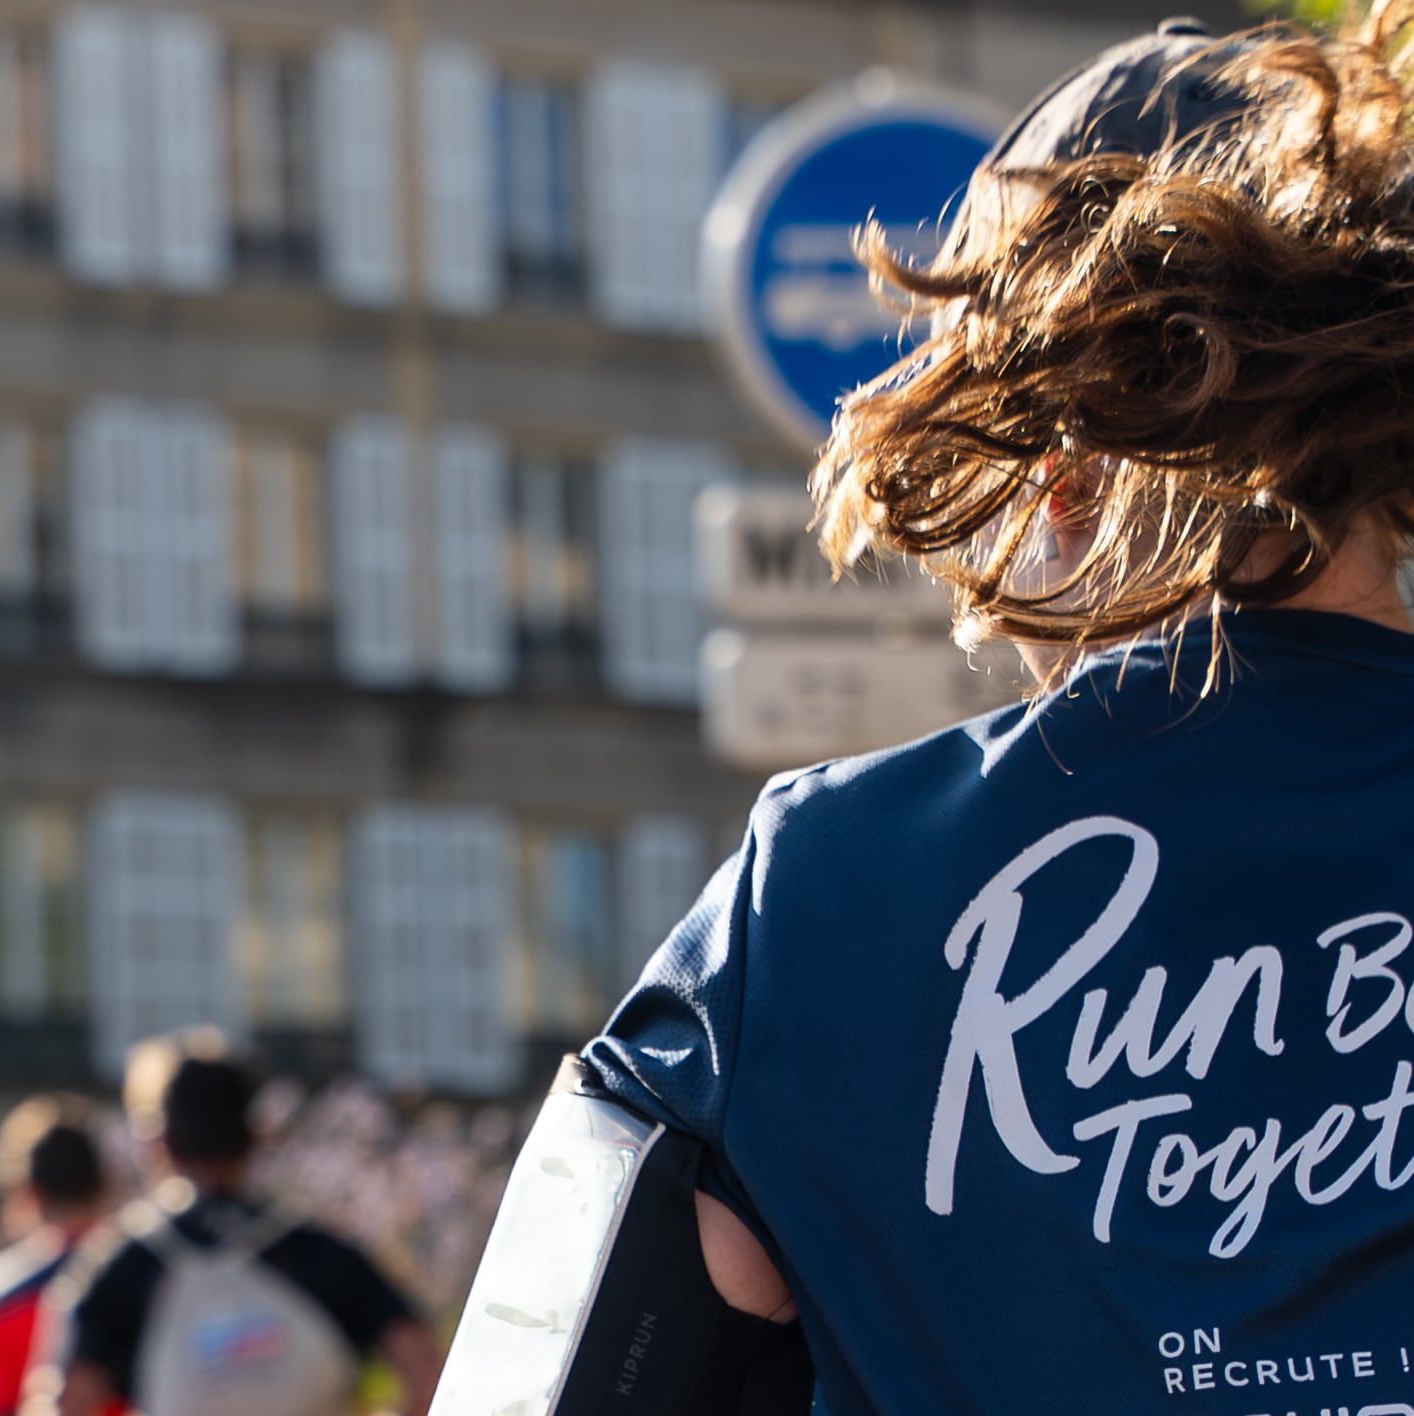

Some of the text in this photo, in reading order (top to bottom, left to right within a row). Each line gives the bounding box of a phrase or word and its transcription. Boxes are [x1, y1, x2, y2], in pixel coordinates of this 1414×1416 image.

[924, 815, 1285, 1216] Run
[613, 1312, 658, 1395] KIPRUN
[1157, 1327, 1222, 1359] ON
[1162, 1351, 1376, 1394] RECRUTE
